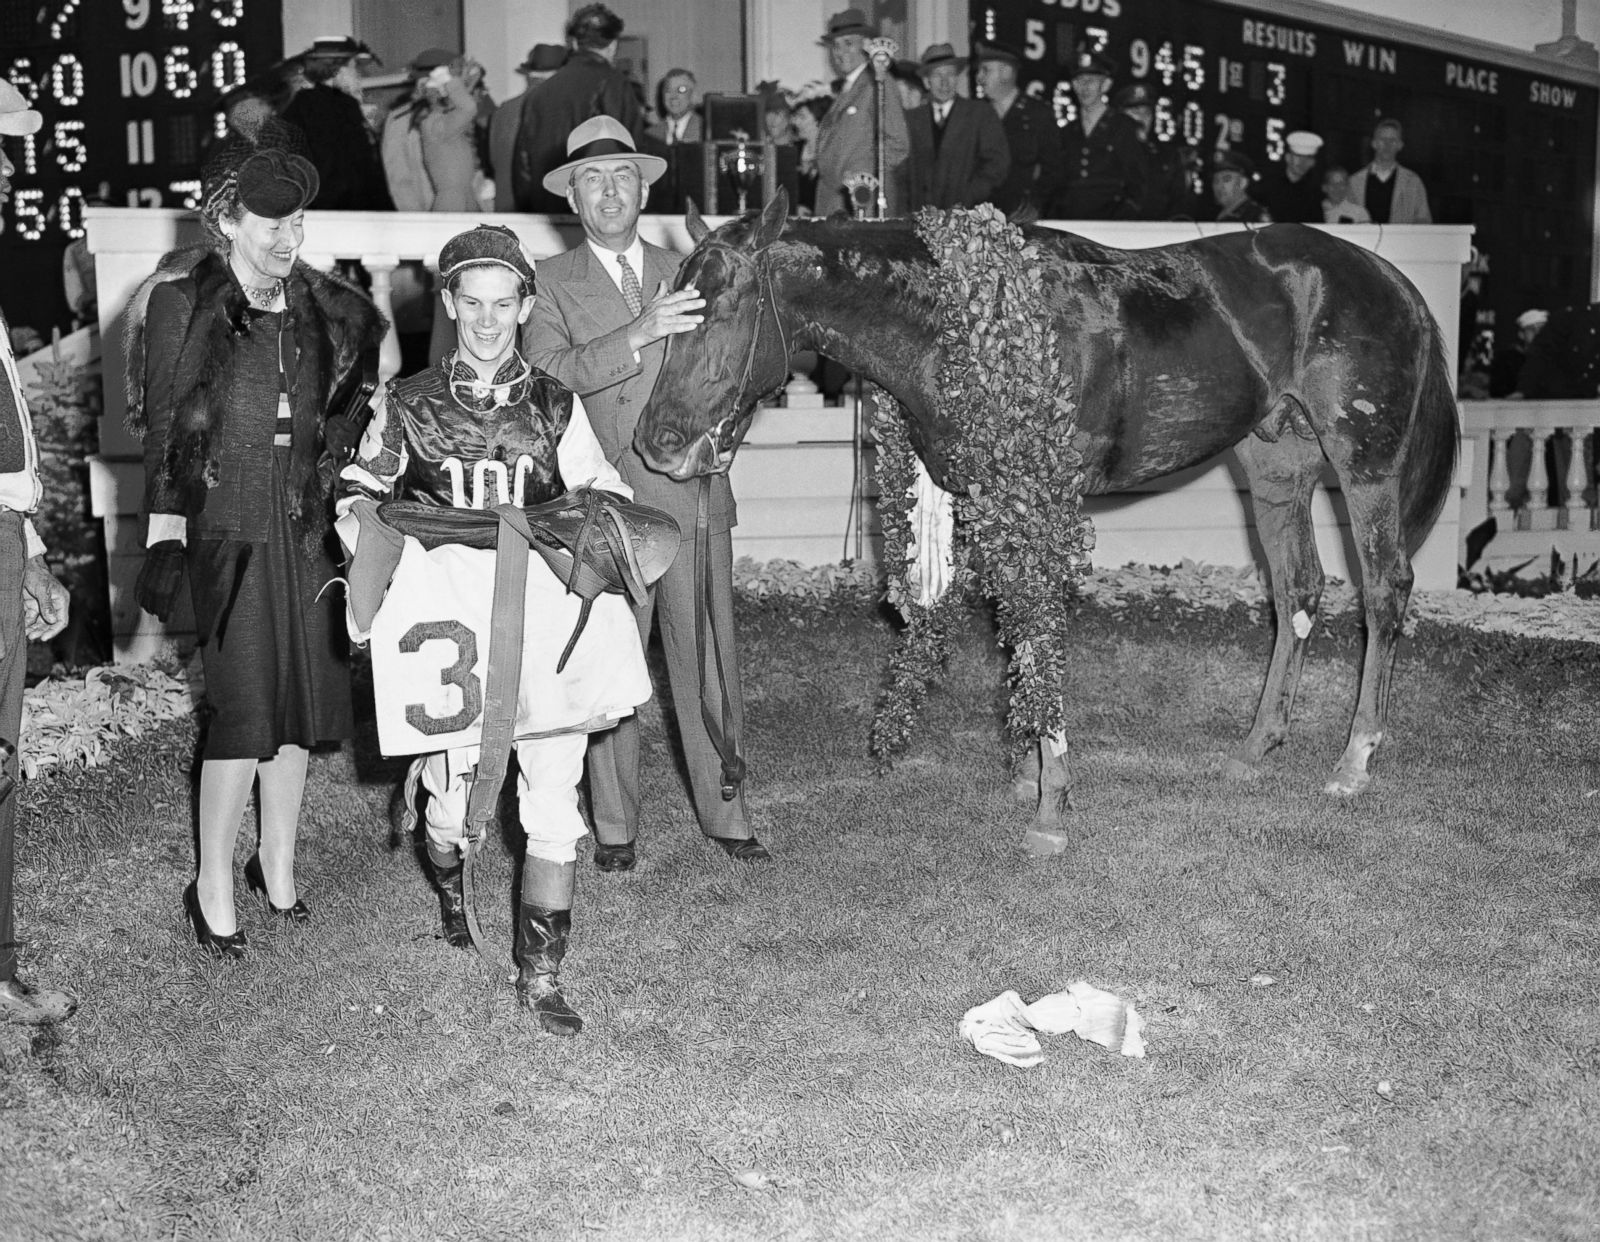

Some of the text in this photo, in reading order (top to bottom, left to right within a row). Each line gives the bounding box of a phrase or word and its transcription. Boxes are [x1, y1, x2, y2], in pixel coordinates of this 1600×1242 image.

[1024, 19, 1046, 60] 5
[1243, 19, 1317, 57] RESULTS
[1343, 41, 1397, 74] WIN
[120, 52, 157, 97] 10
[1267, 62, 1286, 105] 3
[1446, 62, 1499, 94] PLACE
[1529, 81, 1577, 108] SHOW
[126, 120, 155, 164] 11
[1154, 97, 1204, 146] 60
[1266, 118, 1286, 161] 5
[398, 619, 482, 736] 3
